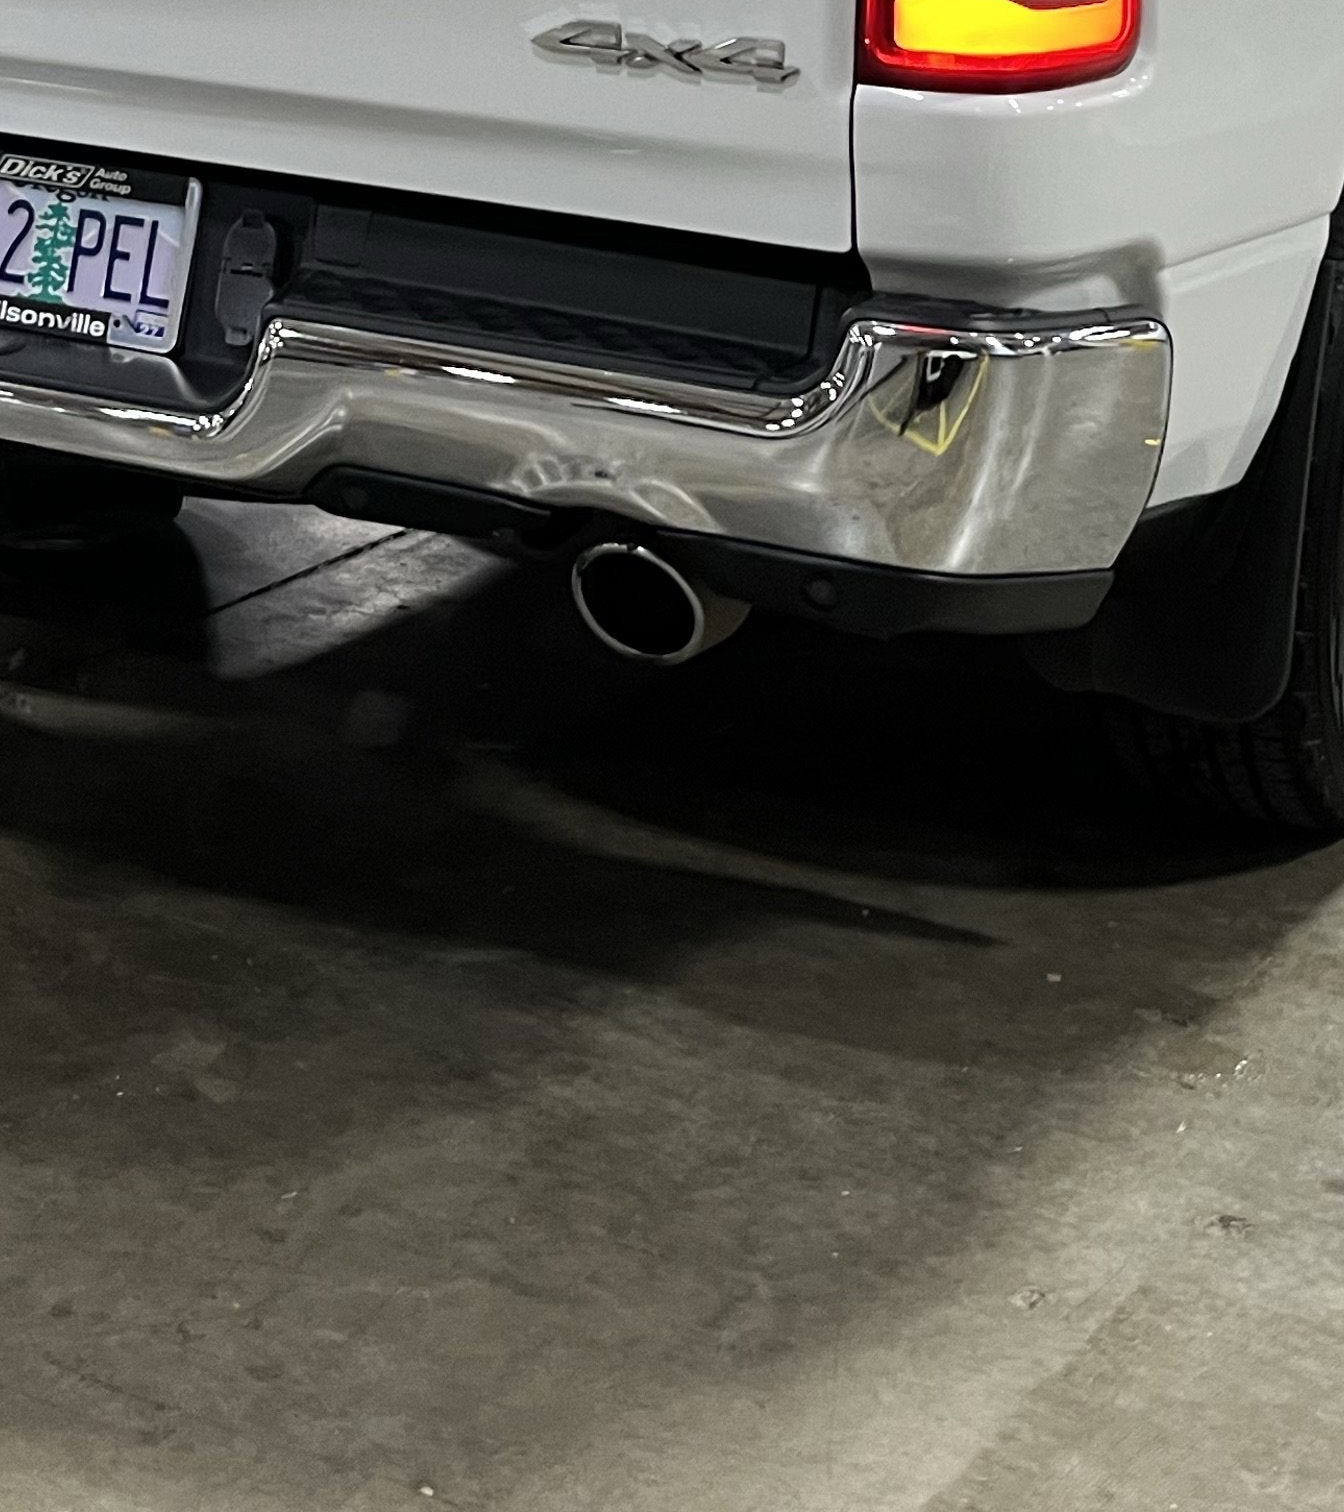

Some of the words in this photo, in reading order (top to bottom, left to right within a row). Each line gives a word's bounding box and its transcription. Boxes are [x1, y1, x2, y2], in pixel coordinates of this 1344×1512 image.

[0, 158, 82, 184] Dick's
[94, 168, 128, 181] Auto
[89, 178, 132, 195] Group
[67, 208, 170, 309] PEL
